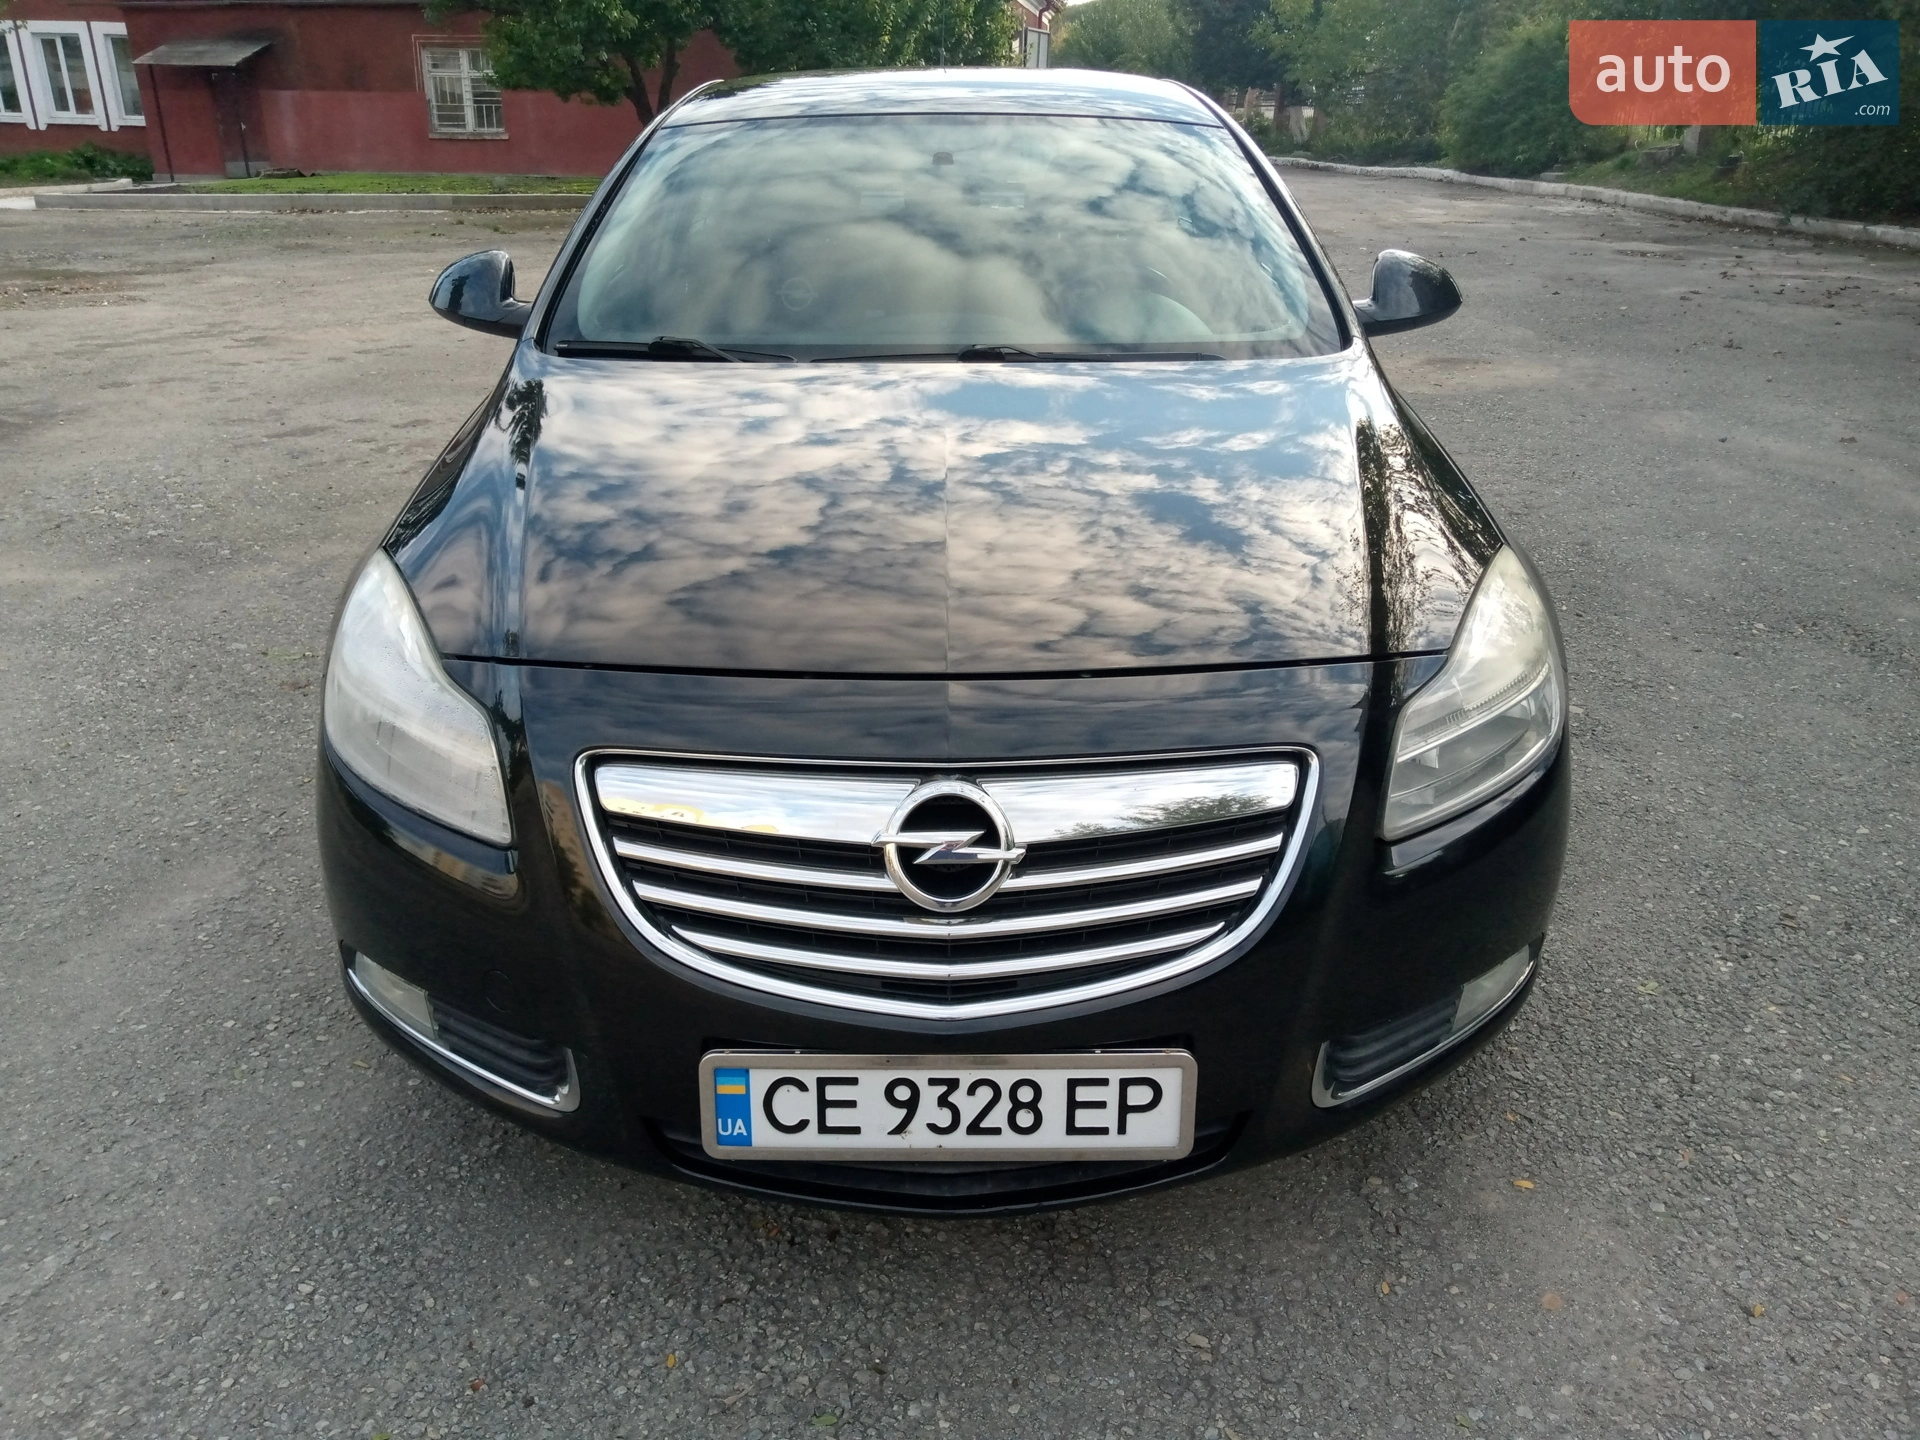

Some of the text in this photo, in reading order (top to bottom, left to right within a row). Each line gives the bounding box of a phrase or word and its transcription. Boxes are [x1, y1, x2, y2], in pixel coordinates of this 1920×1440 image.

[762, 1076, 1164, 1136] CE 9328 EP
[718, 1118, 748, 1137] UA
